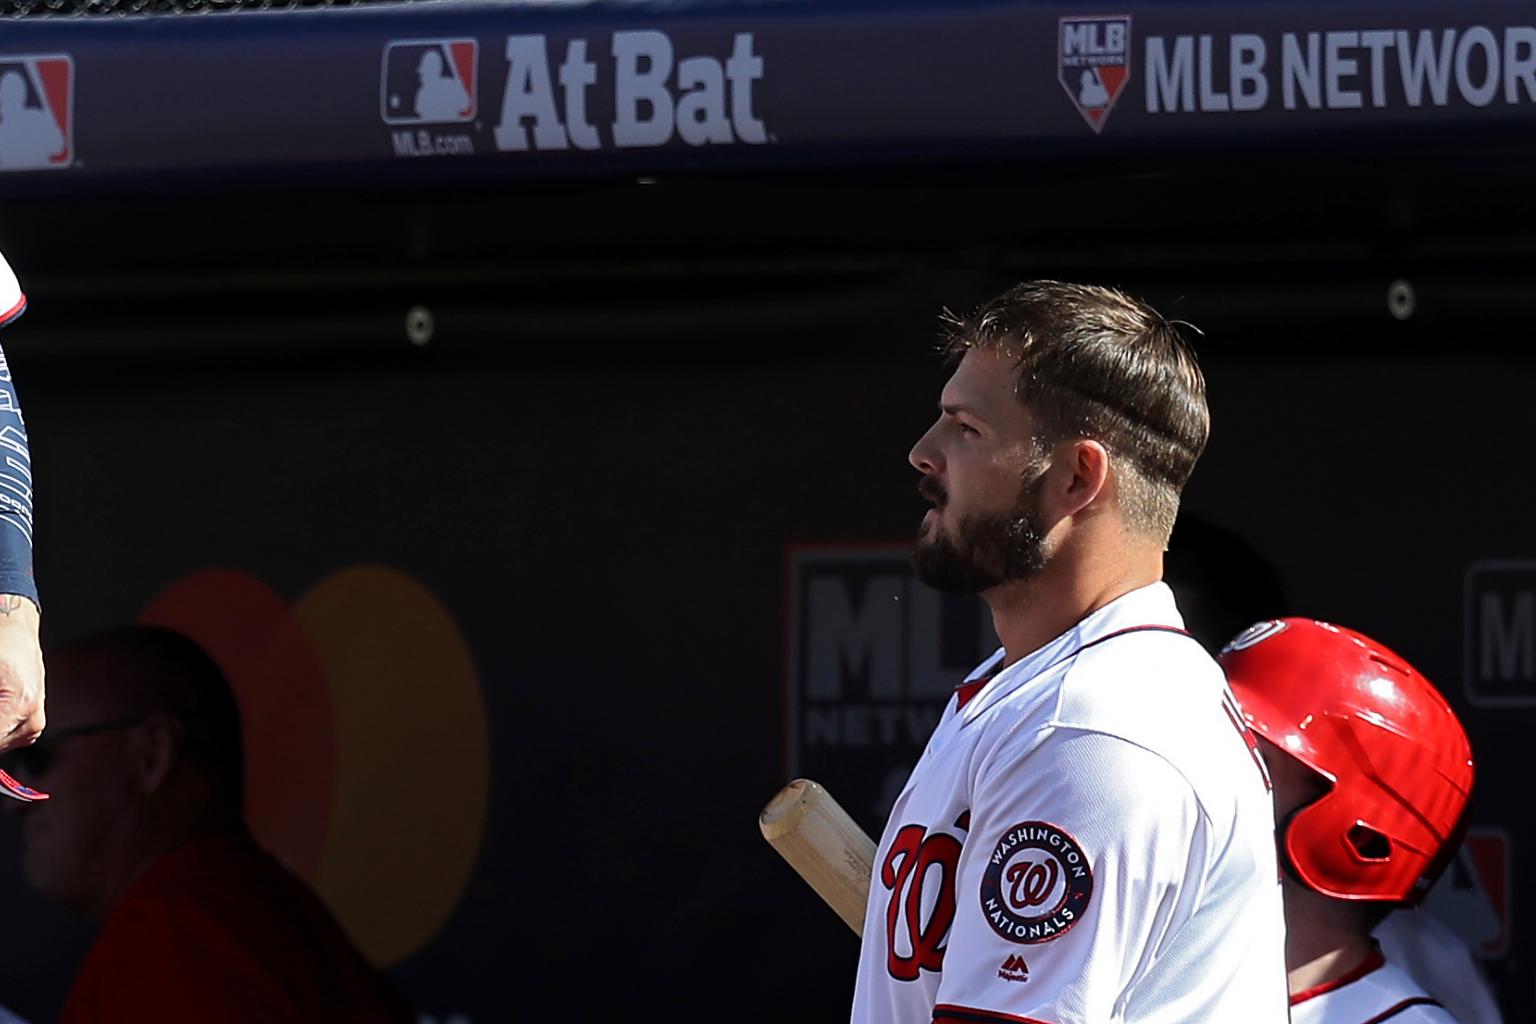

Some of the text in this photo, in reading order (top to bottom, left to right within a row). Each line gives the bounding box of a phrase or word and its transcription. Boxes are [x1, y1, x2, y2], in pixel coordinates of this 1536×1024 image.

[1064, 22, 1125, 55] MLB
[494, 28, 767, 153] At Bat
[1144, 33, 1268, 114] MLB
[992, 827, 1086, 879] WASHINGTON
[986, 897, 1075, 939] NATIONALS
